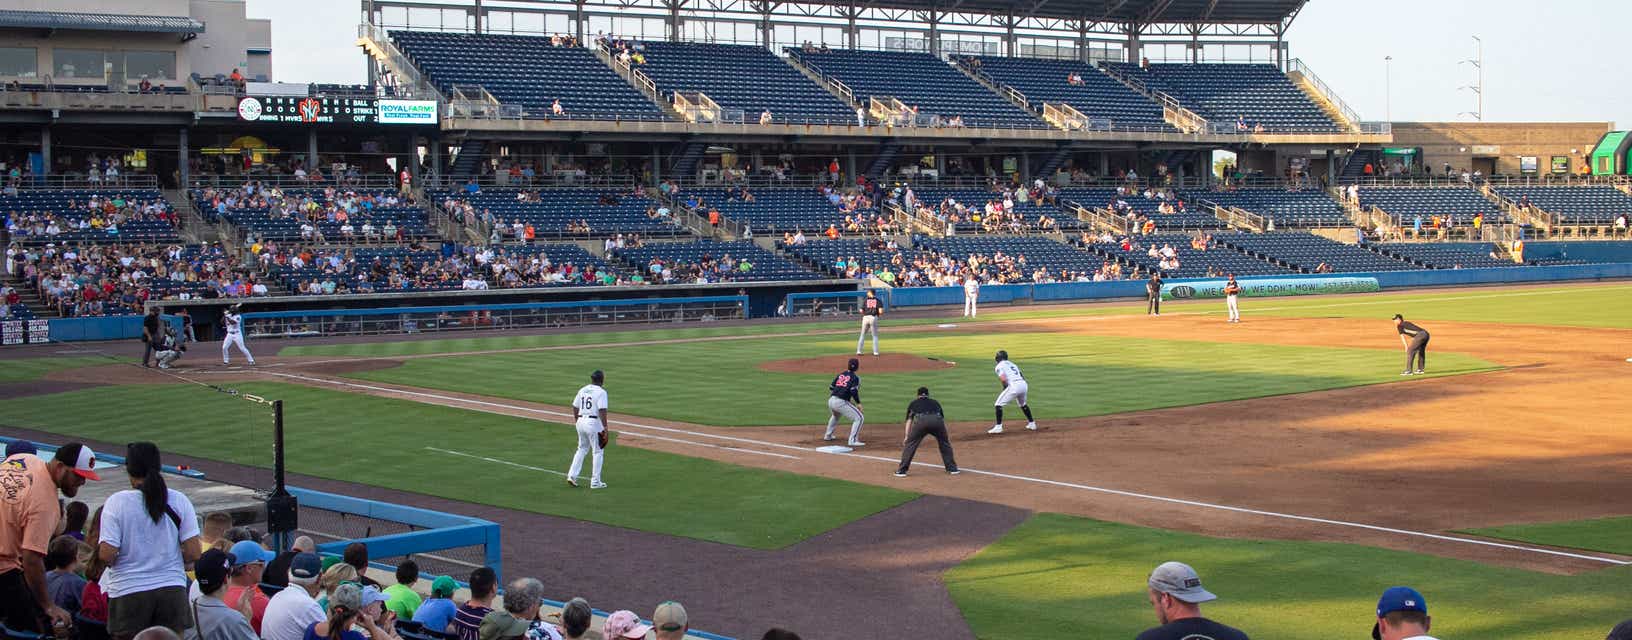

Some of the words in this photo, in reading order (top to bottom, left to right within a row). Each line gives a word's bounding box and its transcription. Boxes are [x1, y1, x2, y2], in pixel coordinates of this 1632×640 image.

[1201, 288, 1216, 296] WE
[1250, 285, 1264, 293] WE
[1268, 284, 1292, 292] DON'T
[581, 396, 592, 410] 16
